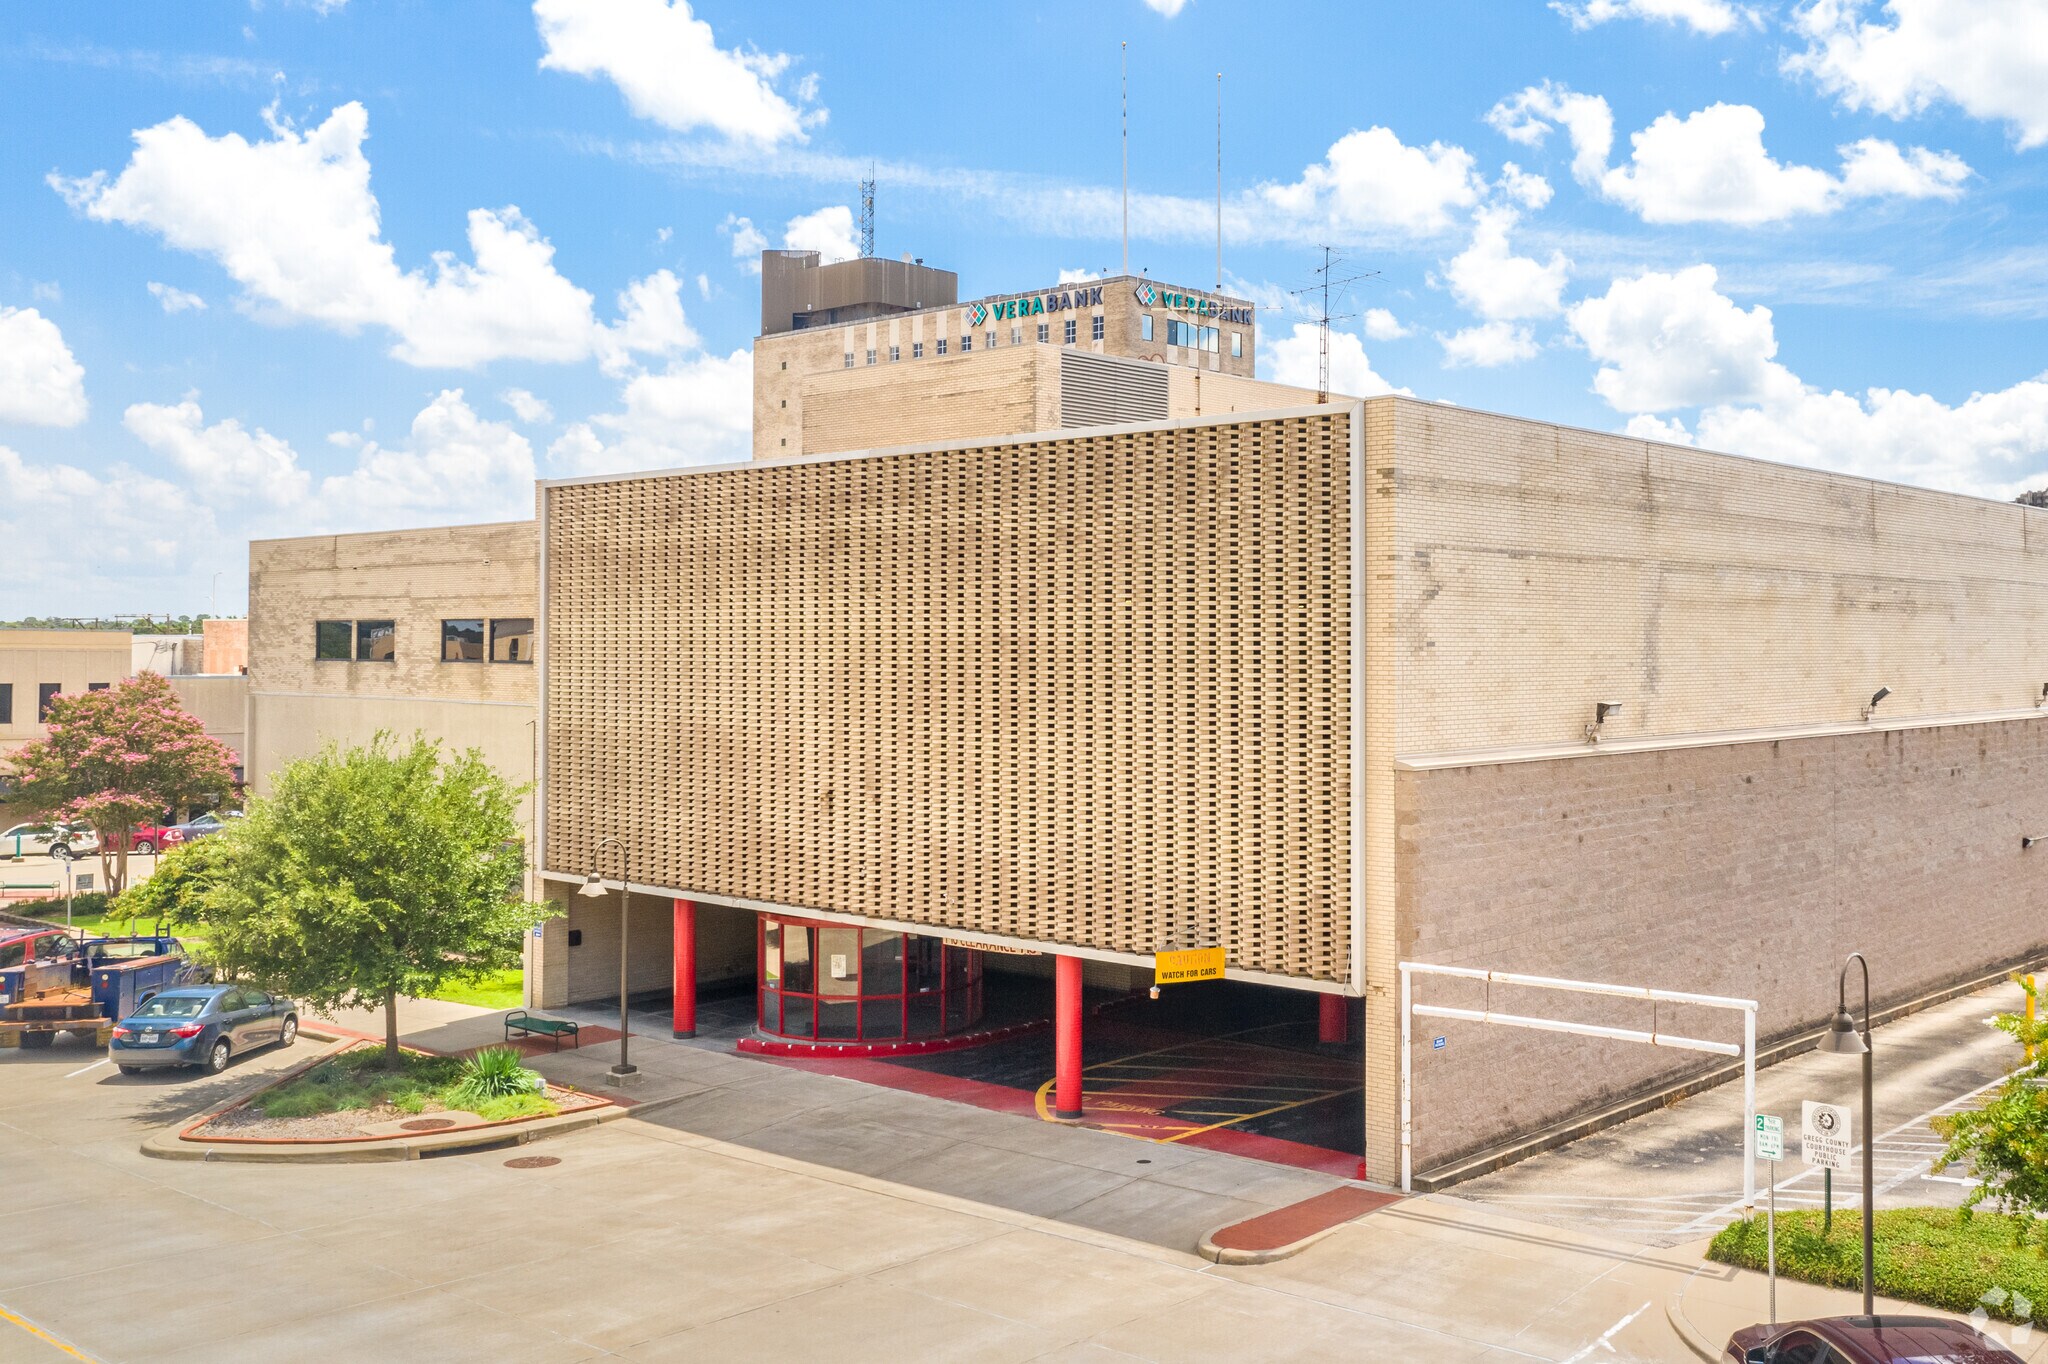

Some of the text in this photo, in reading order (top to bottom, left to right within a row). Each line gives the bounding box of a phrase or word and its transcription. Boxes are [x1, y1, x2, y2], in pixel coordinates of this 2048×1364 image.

[992, 286, 1103, 321] VERABANK
[1162, 290, 1252, 325] VERABANK
[1169, 952, 1211, 966] CAUTION
[1161, 967, 1217, 979] WATCH FOR CARS
[1757, 1117, 1764, 1130] 2
[1803, 1134, 1850, 1148] GREGG COUNTY
[1806, 1142, 1846, 1156] COURTHOUSE
[1814, 1150, 1837, 1161] PUBLIC
[1811, 1157, 1840, 1168] PARKING
